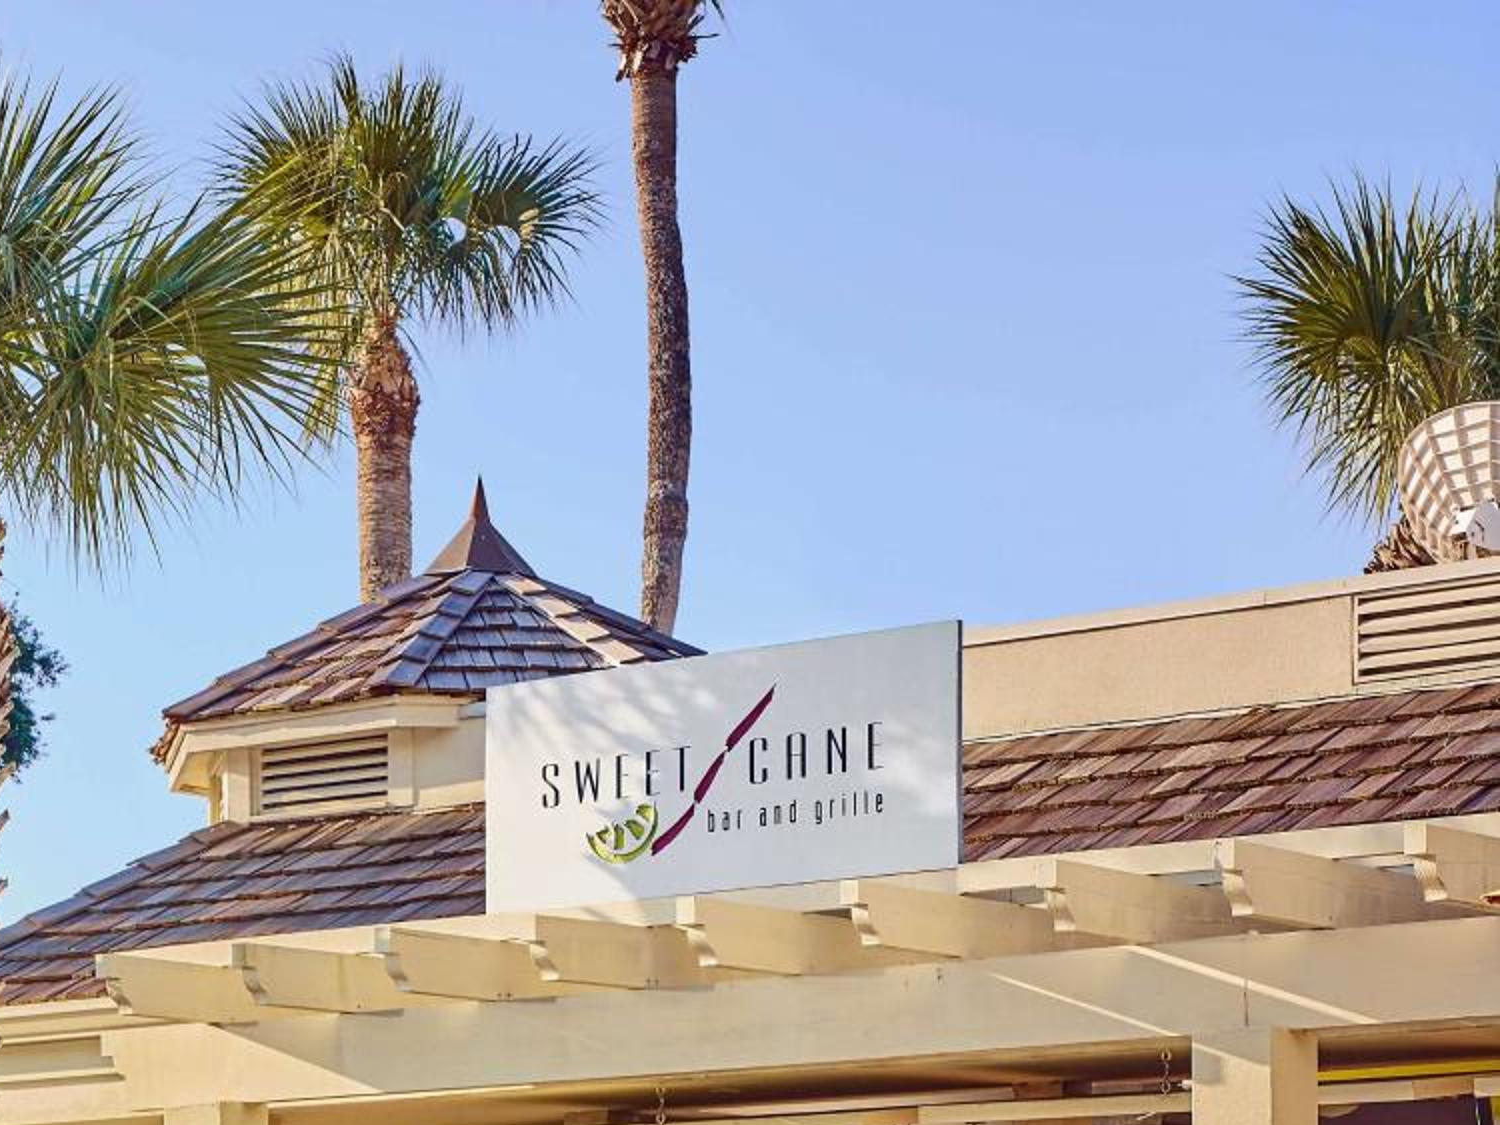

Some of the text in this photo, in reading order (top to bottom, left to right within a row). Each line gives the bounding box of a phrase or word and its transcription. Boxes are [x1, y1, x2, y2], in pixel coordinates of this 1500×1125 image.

[541, 721, 885, 809] SWEET CANE
[707, 789, 884, 833] bar and grille
